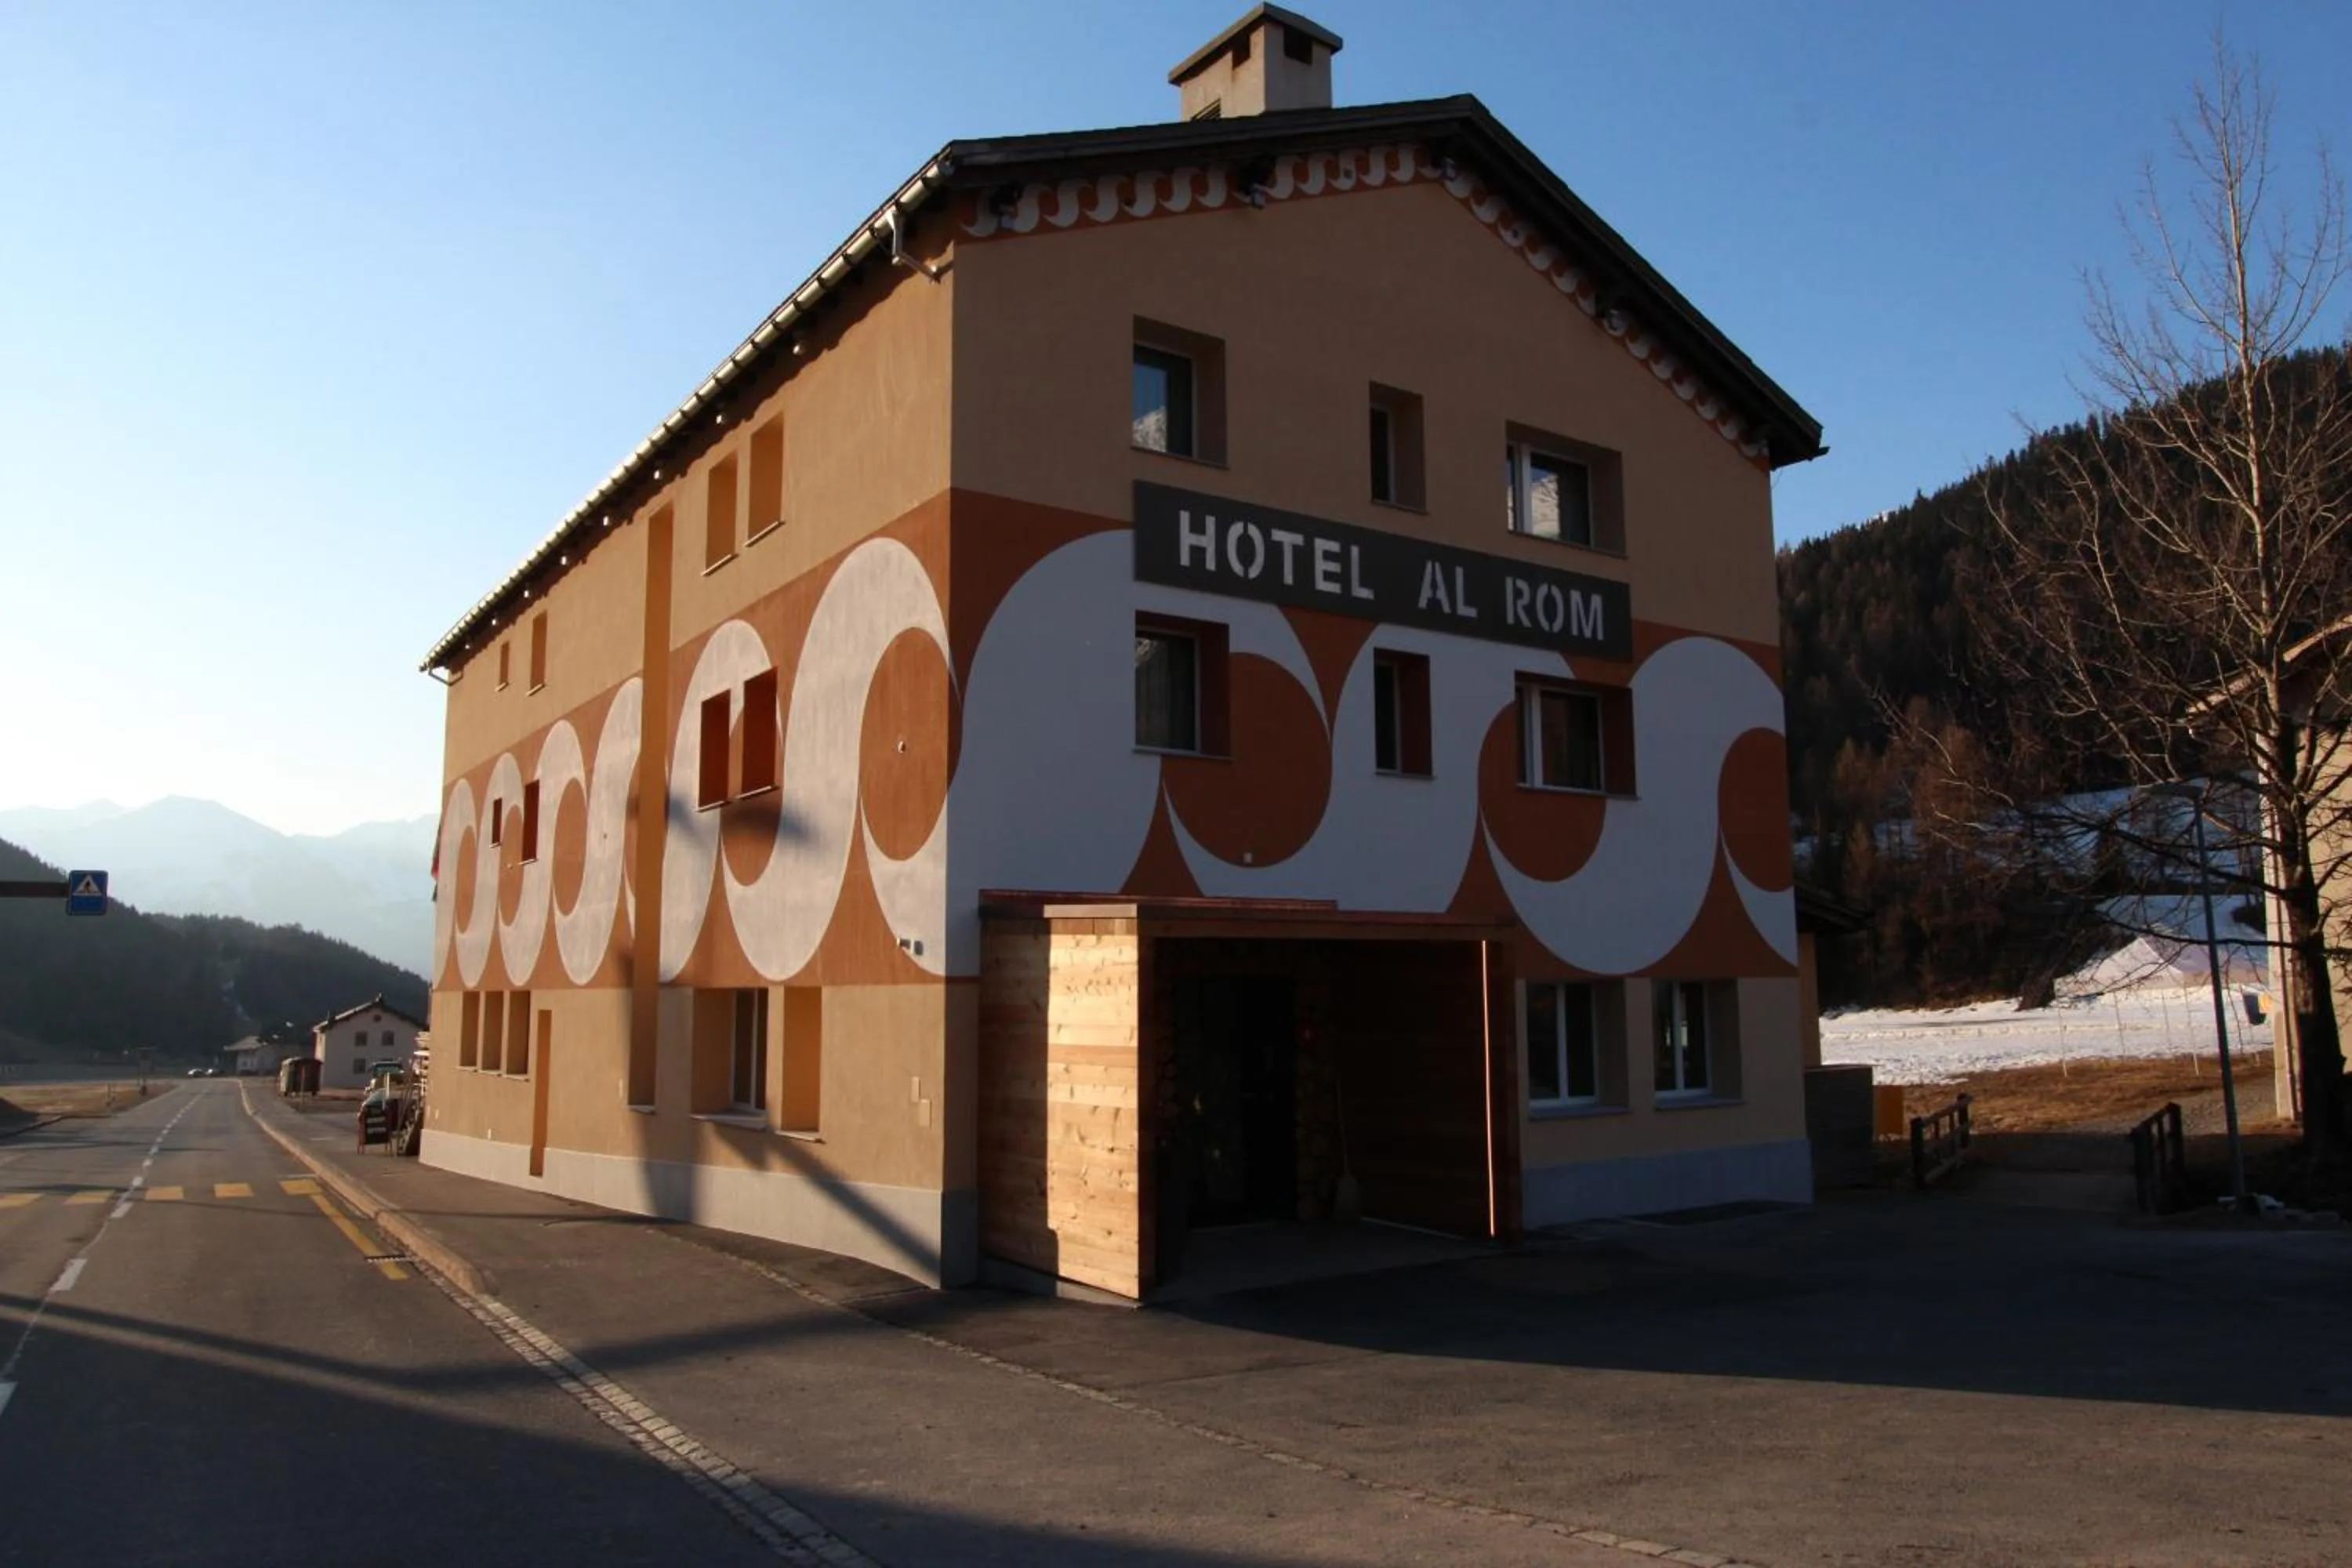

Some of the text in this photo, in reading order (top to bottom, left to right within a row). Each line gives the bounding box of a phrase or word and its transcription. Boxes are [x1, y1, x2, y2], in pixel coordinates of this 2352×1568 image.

[1178, 510, 1604, 641] HOTEL AL ROM
